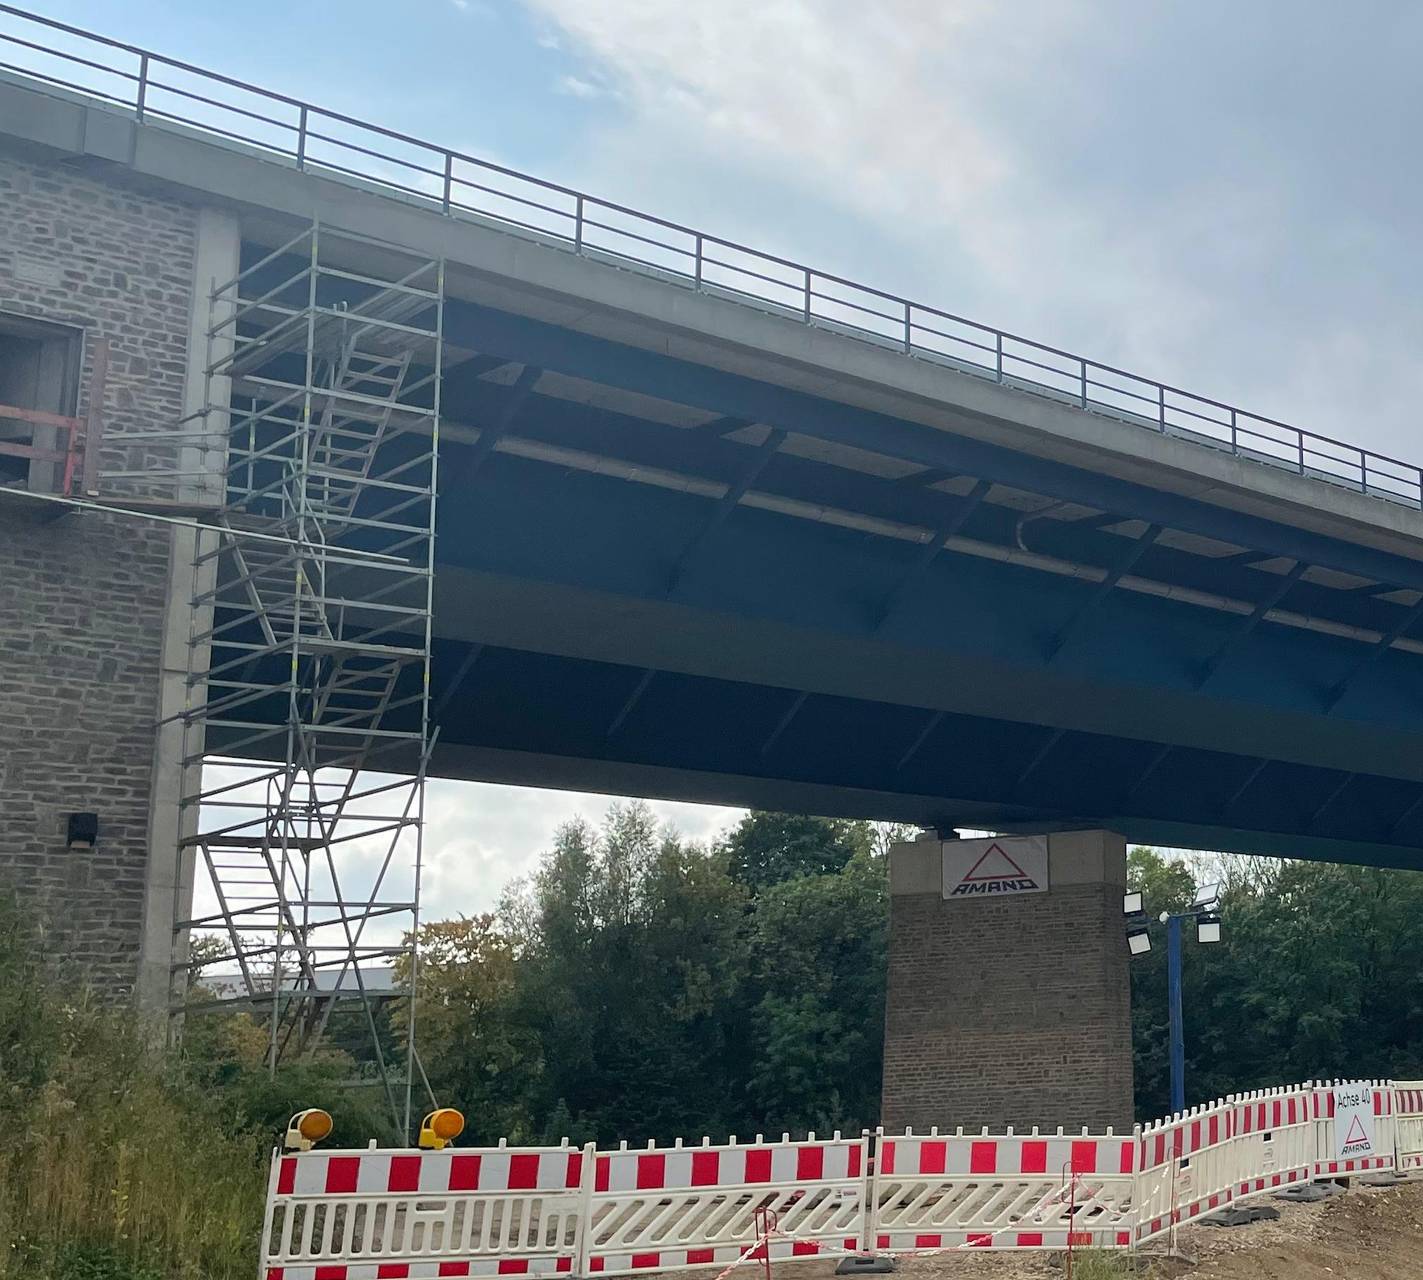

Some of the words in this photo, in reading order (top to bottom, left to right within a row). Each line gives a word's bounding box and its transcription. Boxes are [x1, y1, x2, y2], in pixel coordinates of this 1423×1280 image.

[952, 880, 1039, 895] AMAND
[1337, 1092, 1359, 1109] Achse
[1361, 1088, 1371, 1104] 40
[1341, 1142, 1371, 1155] AMAND
